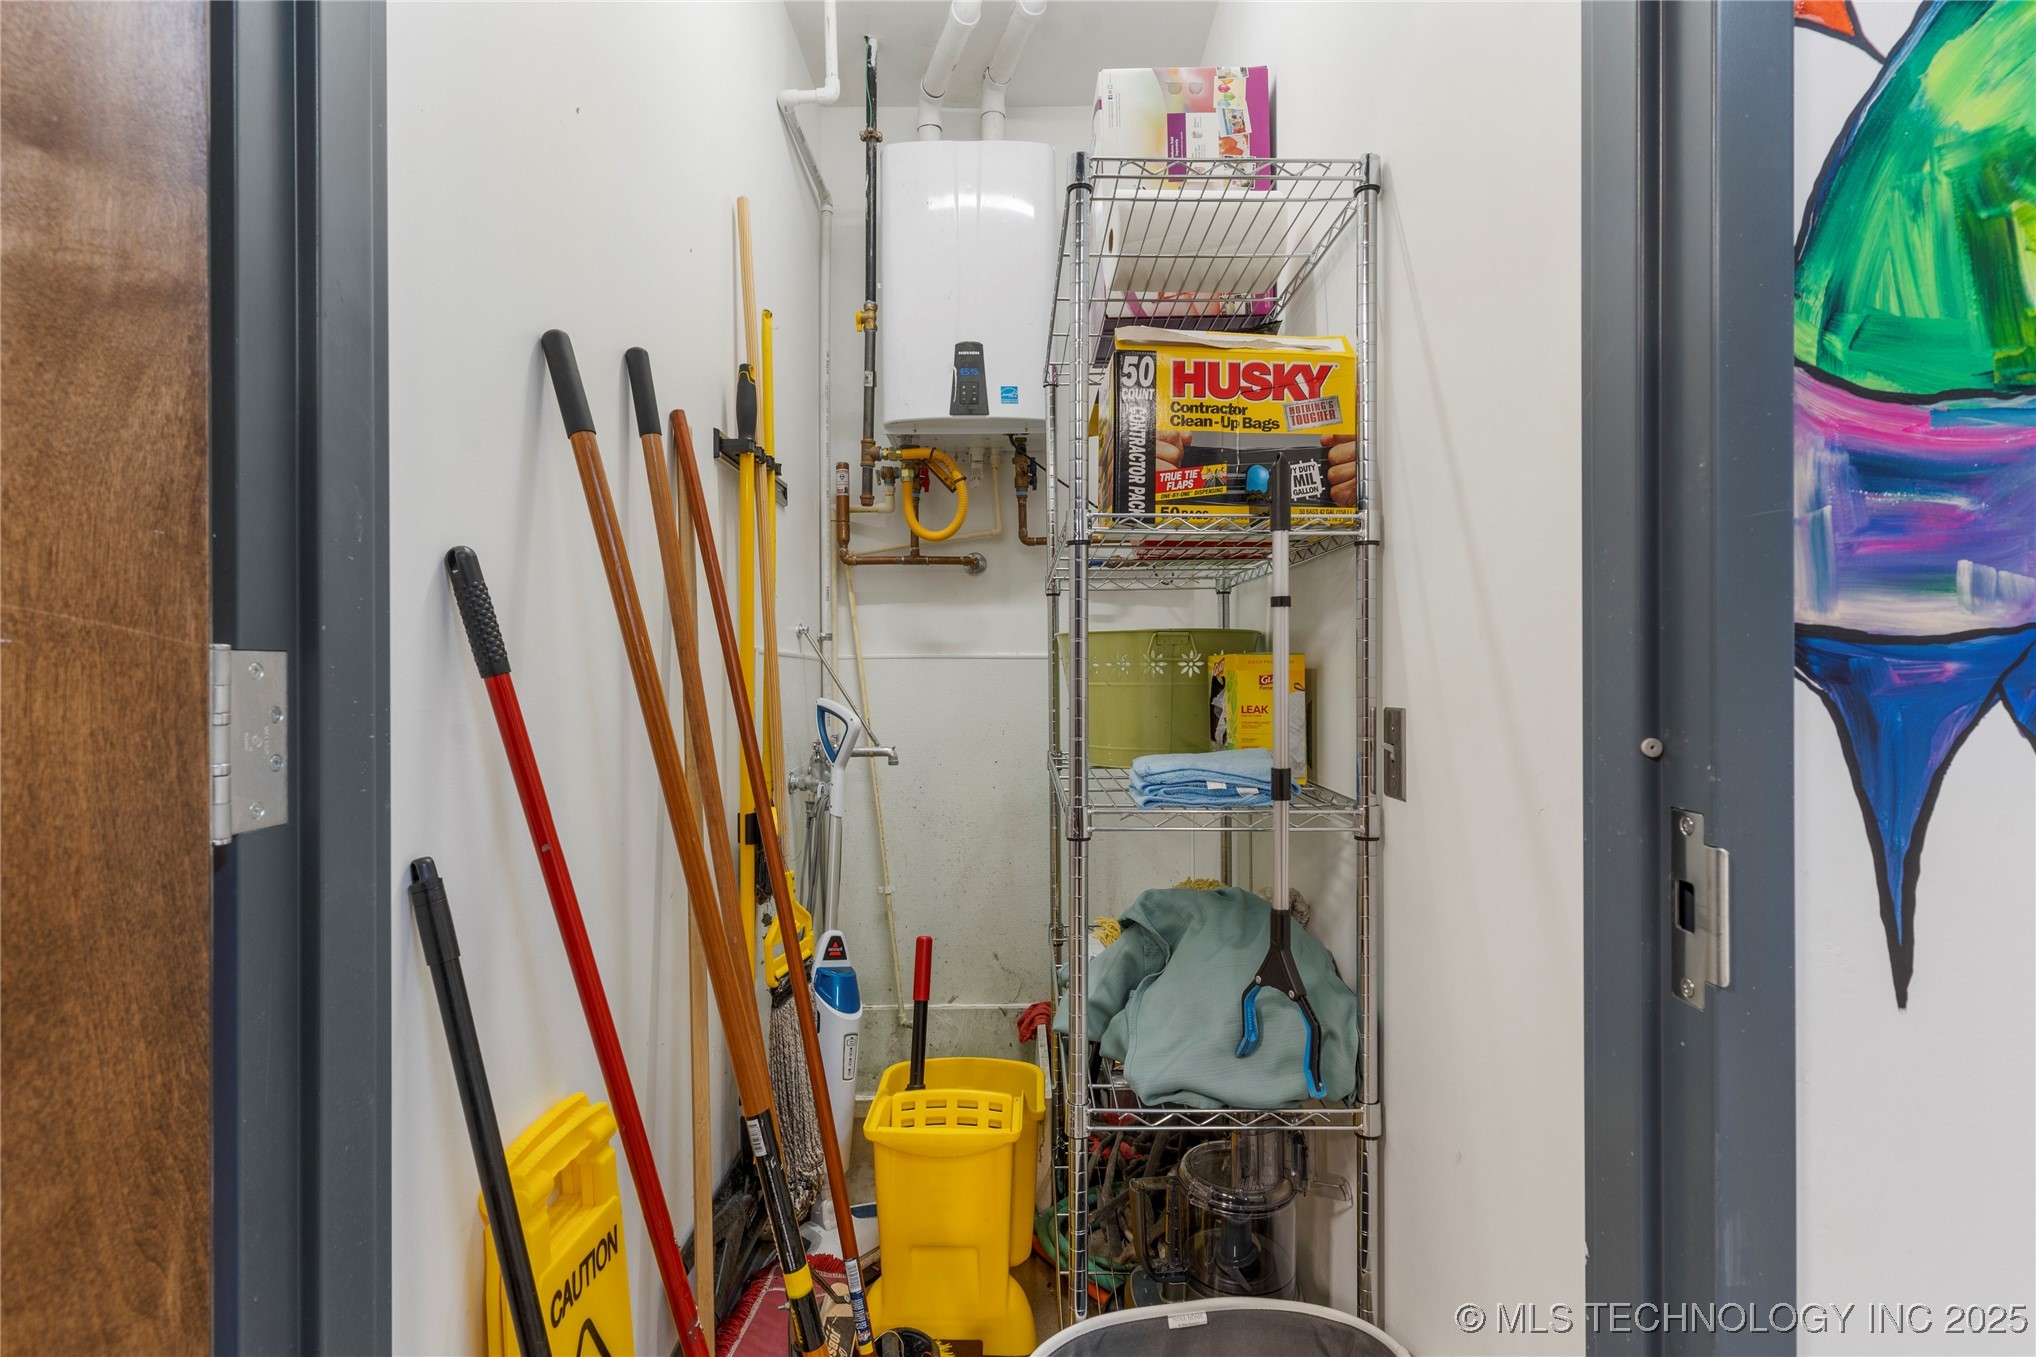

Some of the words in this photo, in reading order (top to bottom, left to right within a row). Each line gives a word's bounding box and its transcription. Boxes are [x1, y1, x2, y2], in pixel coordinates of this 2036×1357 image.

[1122, 355, 1155, 388] 50
[1171, 359, 1335, 402] HUSKY
[1122, 387, 1155, 401] COUNT
[1170, 401, 1248, 416] Contractor
[1288, 400, 1335, 415] NOTHING'S
[1242, 417, 1280, 432] Bags
[1128, 405, 1147, 483] CONTRACTOR
[1159, 471, 1183, 482] TRUE
[1184, 469, 1199, 480] TIE
[1298, 464, 1316, 473] DUTY
[1166, 479, 1194, 491] FLAPS
[1293, 472, 1317, 488] MIL
[1193, 487, 1224, 496] DISPENSING
[1293, 486, 1319, 496] GALLON
[1260, 675, 1274, 685] GL
[1241, 705, 1269, 714] LEAK
[551, 1224, 618, 1328] CAUTION
